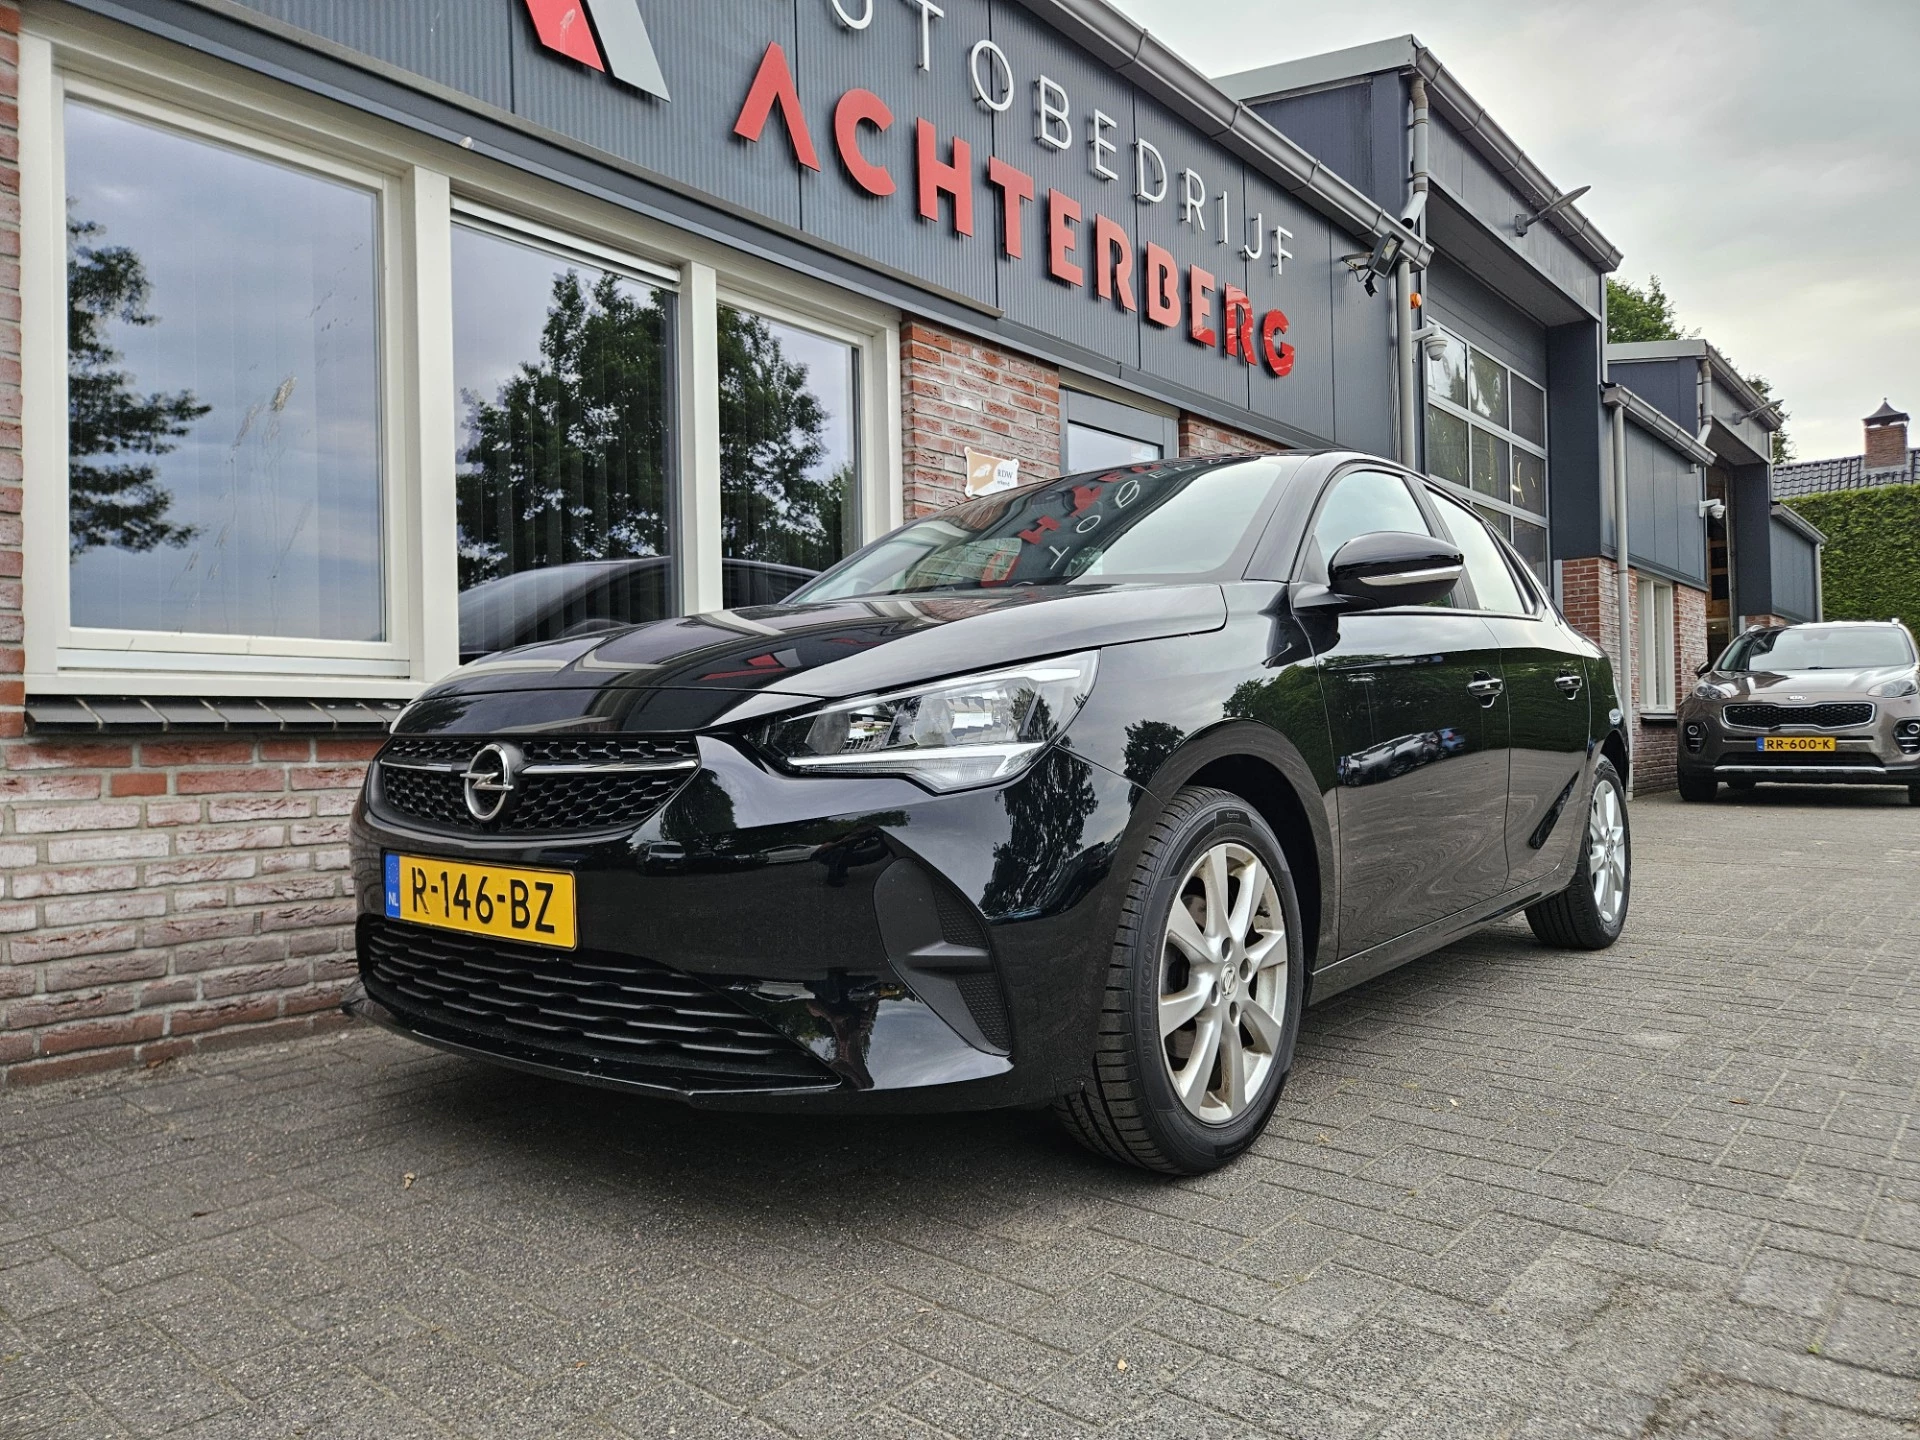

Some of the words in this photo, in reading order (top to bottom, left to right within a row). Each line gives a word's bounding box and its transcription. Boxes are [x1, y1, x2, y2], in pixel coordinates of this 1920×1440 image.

[733, 41, 1295, 377] ACHTERBERG
[997, 469, 1013, 479] RDW
[1766, 739, 1831, 750] RR-600-K
[388, 891, 399, 907] NL
[411, 866, 555, 934] R-146-BZ
